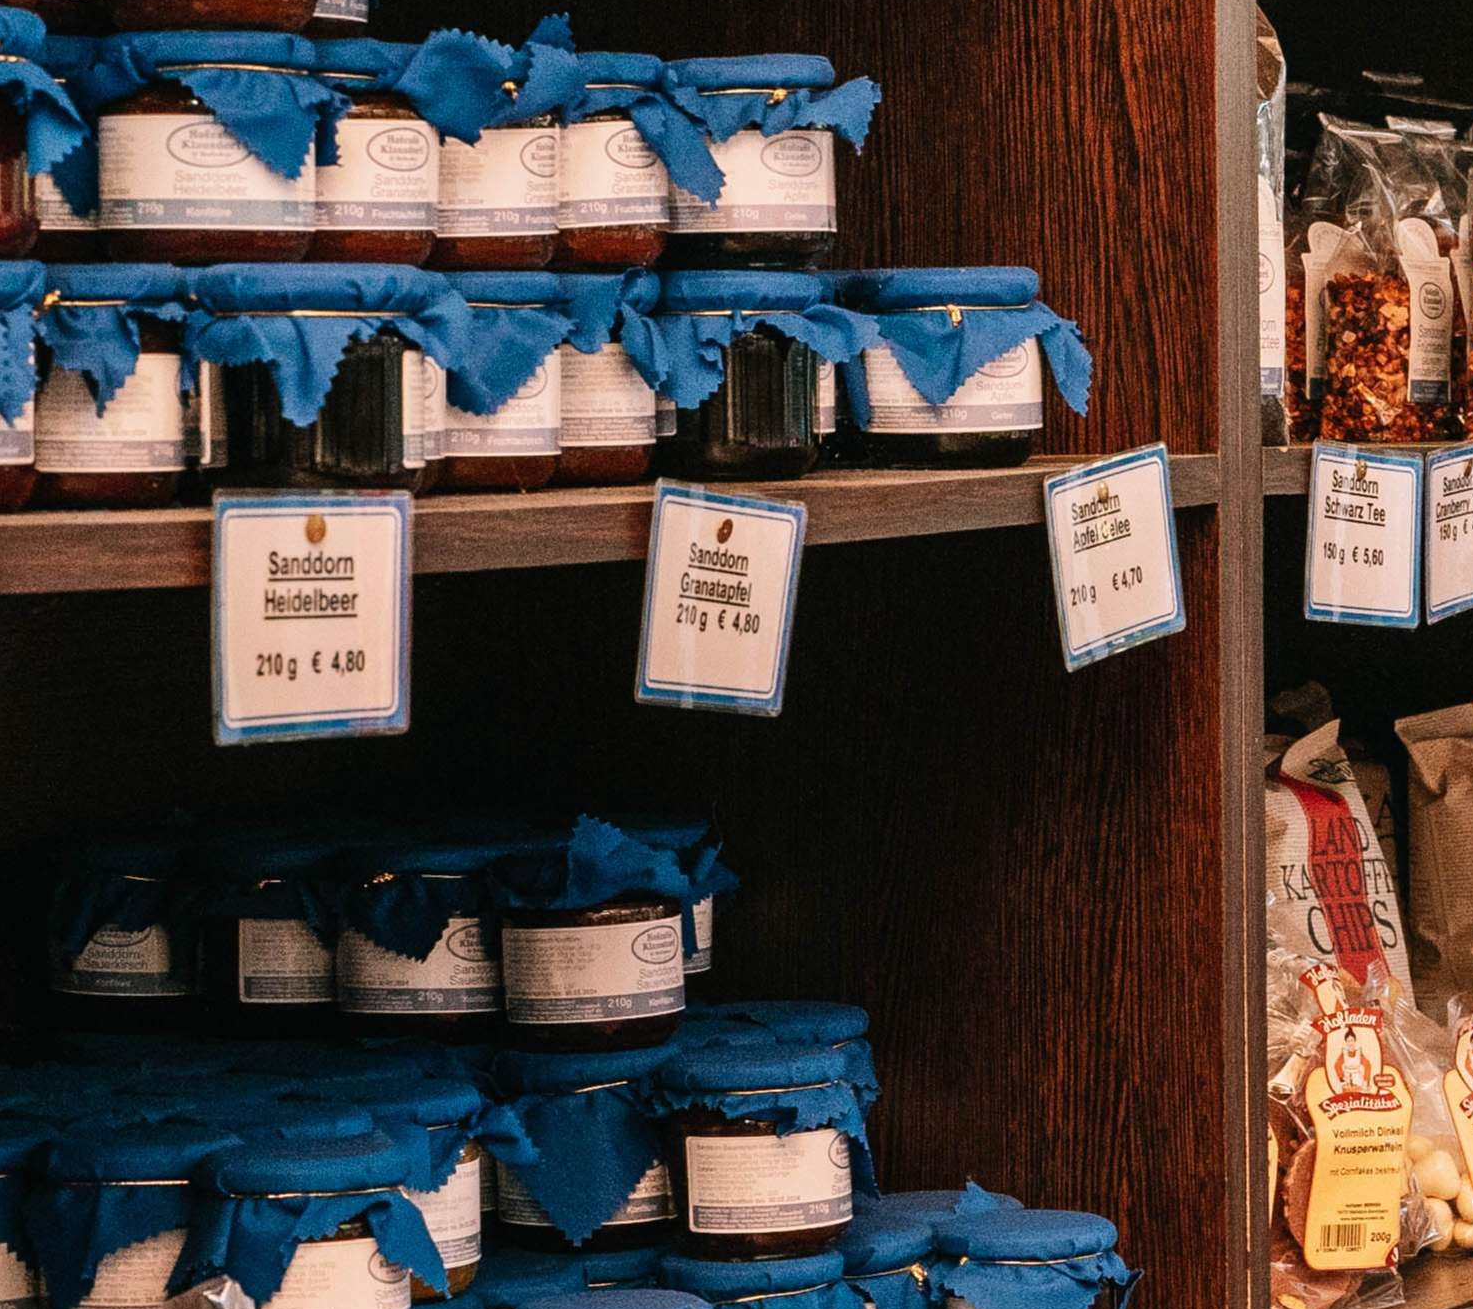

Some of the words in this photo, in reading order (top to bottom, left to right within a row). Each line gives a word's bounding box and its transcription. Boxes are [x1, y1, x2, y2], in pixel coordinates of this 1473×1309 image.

[333, 201, 365, 219] 210g
[493, 210, 521, 224] 210g
[579, 201, 609, 216] 210g
[731, 207, 760, 220] 210g
[941, 408, 969, 421] 210g
[1331, 469, 1380, 494] Sanddorn
[1070, 491, 1121, 522] Sanddorn
[1324, 496, 1366, 521] Schwarz
[1365, 503, 1386, 523] Tee
[1435, 496, 1470, 522] Cranberry
[267, 550, 355, 578] Sanddorn
[687, 541, 750, 572] Sanddorn
[679, 570, 752, 605] Granatapfel
[264, 588, 358, 615] Heidelbeer
[675, 602, 698, 626] 210
[699, 611, 708, 633] g
[718, 608, 727, 632] €
[732, 611, 760, 636] 4,80
[255, 652, 284, 677] 210
[287, 658, 298, 681] g
[311, 651, 322, 675] €
[330, 649, 366, 677] 4,80
[1309, 814, 1371, 856] LAND
[1305, 898, 1400, 957] CHIPS
[607, 996, 633, 1010] 210g
[1321, 1011, 1378, 1035] Hofladen
[1322, 1094, 1401, 1118] Spezialitäten
[1332, 1126, 1374, 1139] Vollmilch
[1376, 1125, 1405, 1139] Dinkel
[1333, 1141, 1404, 1156] Knusperwaffeln
[1369, 1231, 1393, 1246] 200g
